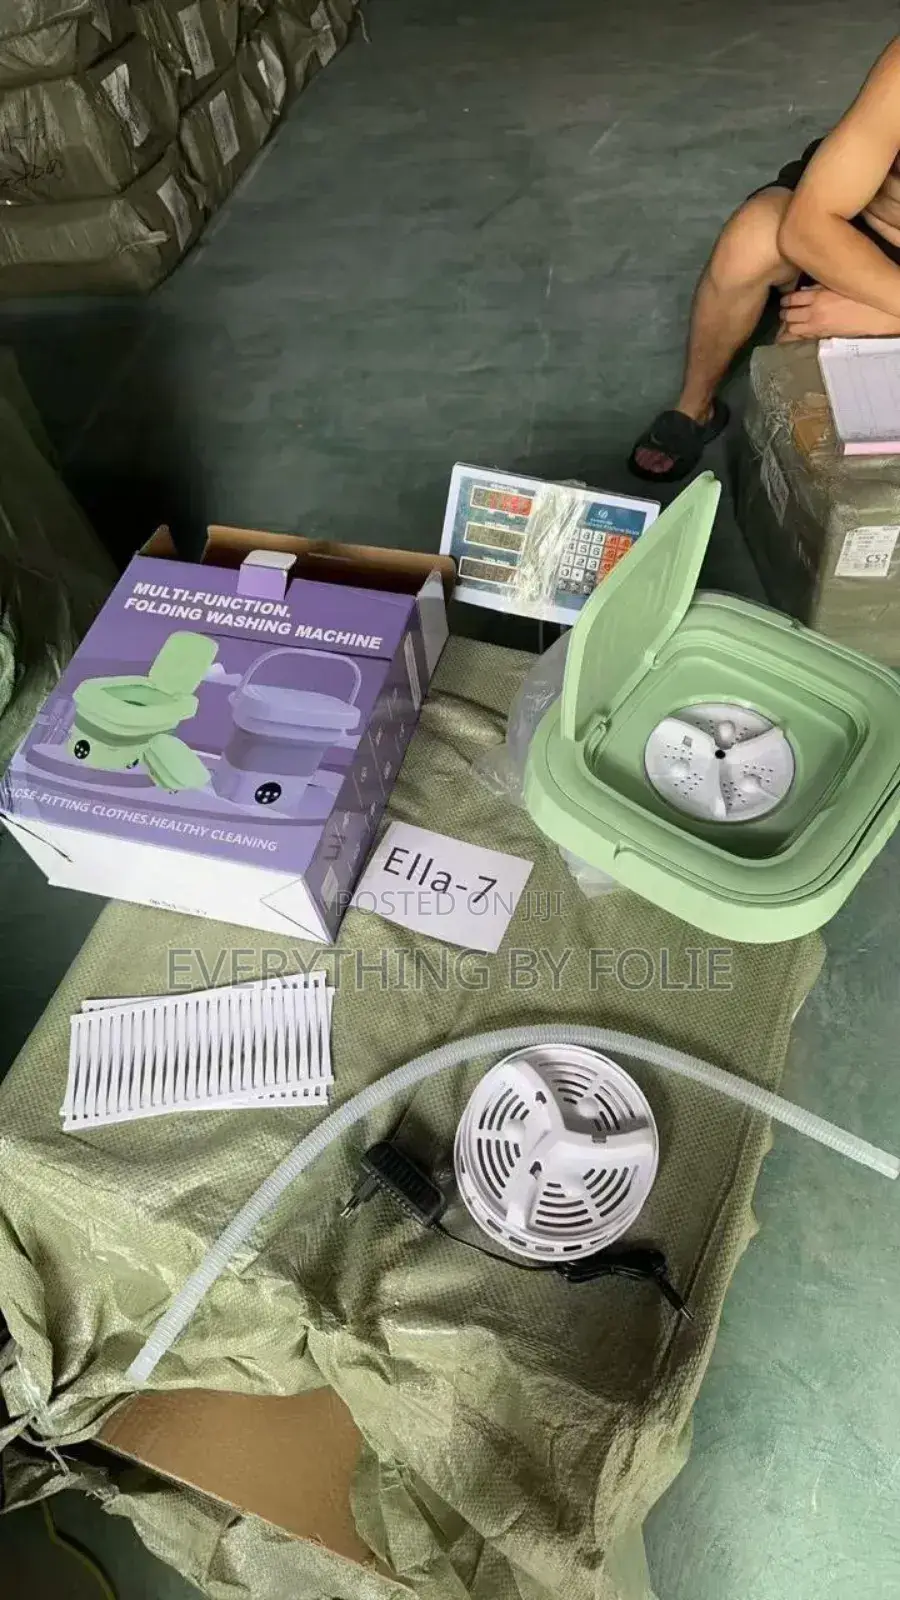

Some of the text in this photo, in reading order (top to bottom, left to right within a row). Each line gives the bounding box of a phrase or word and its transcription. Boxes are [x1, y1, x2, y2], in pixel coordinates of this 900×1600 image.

[124, 598, 383, 650] FOLDING WASHING MACHINE
[211, 829, 278, 852] CLEANING
[383, 847, 498, 903] Ella-7
